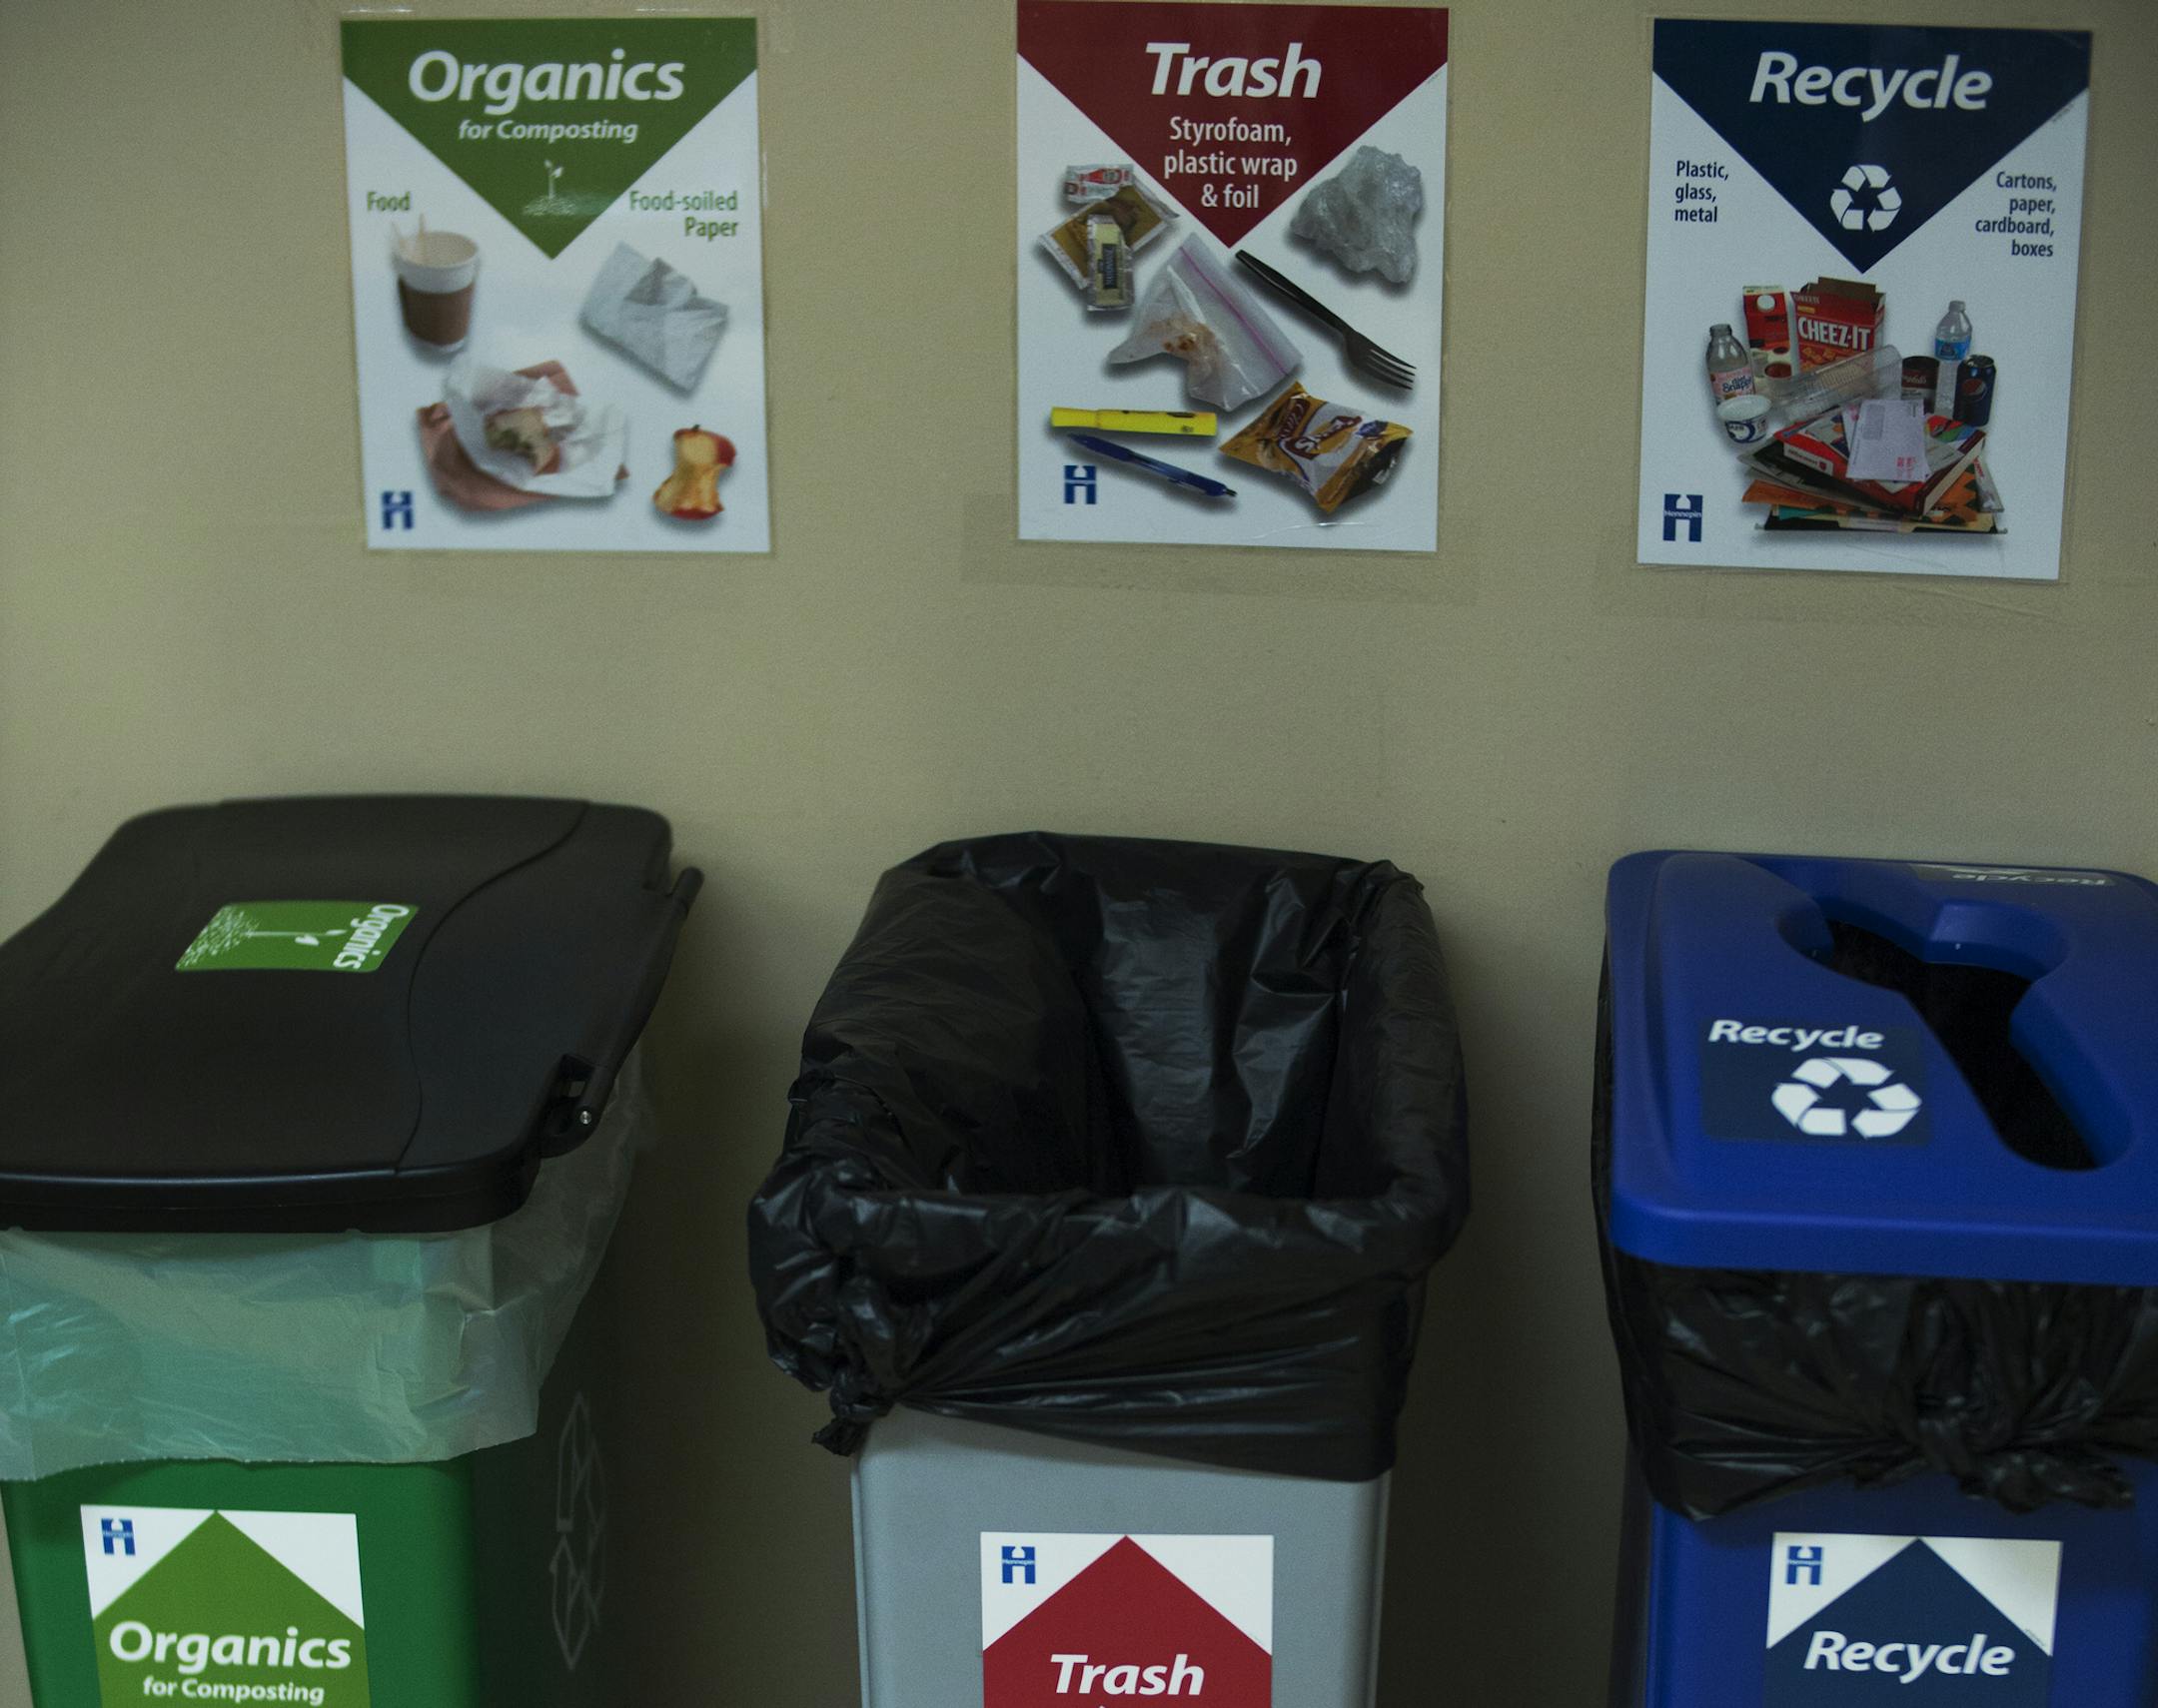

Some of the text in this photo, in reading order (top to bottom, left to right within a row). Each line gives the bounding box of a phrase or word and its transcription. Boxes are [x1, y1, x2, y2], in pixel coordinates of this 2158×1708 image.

[408, 48, 686, 116] Organics
[1145, 42, 1323, 99] Trash
[1748, 51, 1994, 123] Recycle
[458, 119, 639, 144] for Composting
[1169, 116, 1293, 146] Styrofoam,
[1163, 149, 1298, 182] plastic wrap
[1675, 160, 1729, 181] Plastic,
[1674, 183, 1717, 204] glass,
[1995, 171, 2058, 193] Cartons,
[366, 191, 412, 212] Food
[629, 190, 738, 212] Food-soiled
[1200, 184, 1259, 209] & foil
[2008, 196, 2056, 217] paper,
[1673, 203, 1718, 224] metal
[684, 217, 738, 241] Paper
[1974, 217, 2055, 237] cardboard,
[2010, 239, 2054, 258] boxes
[1797, 315, 1872, 353] CHEEZ-IT
[1951, 873, 2107, 886] Recycle
[333, 903, 410, 969] Organics
[1708, 1019, 1885, 1052] Recycle
[109, 1620, 352, 1674] Organics
[1803, 1630, 2016, 1685] Recycle
[1050, 1653, 1205, 1696] Trash
[143, 1676, 326, 1706] for Composting
